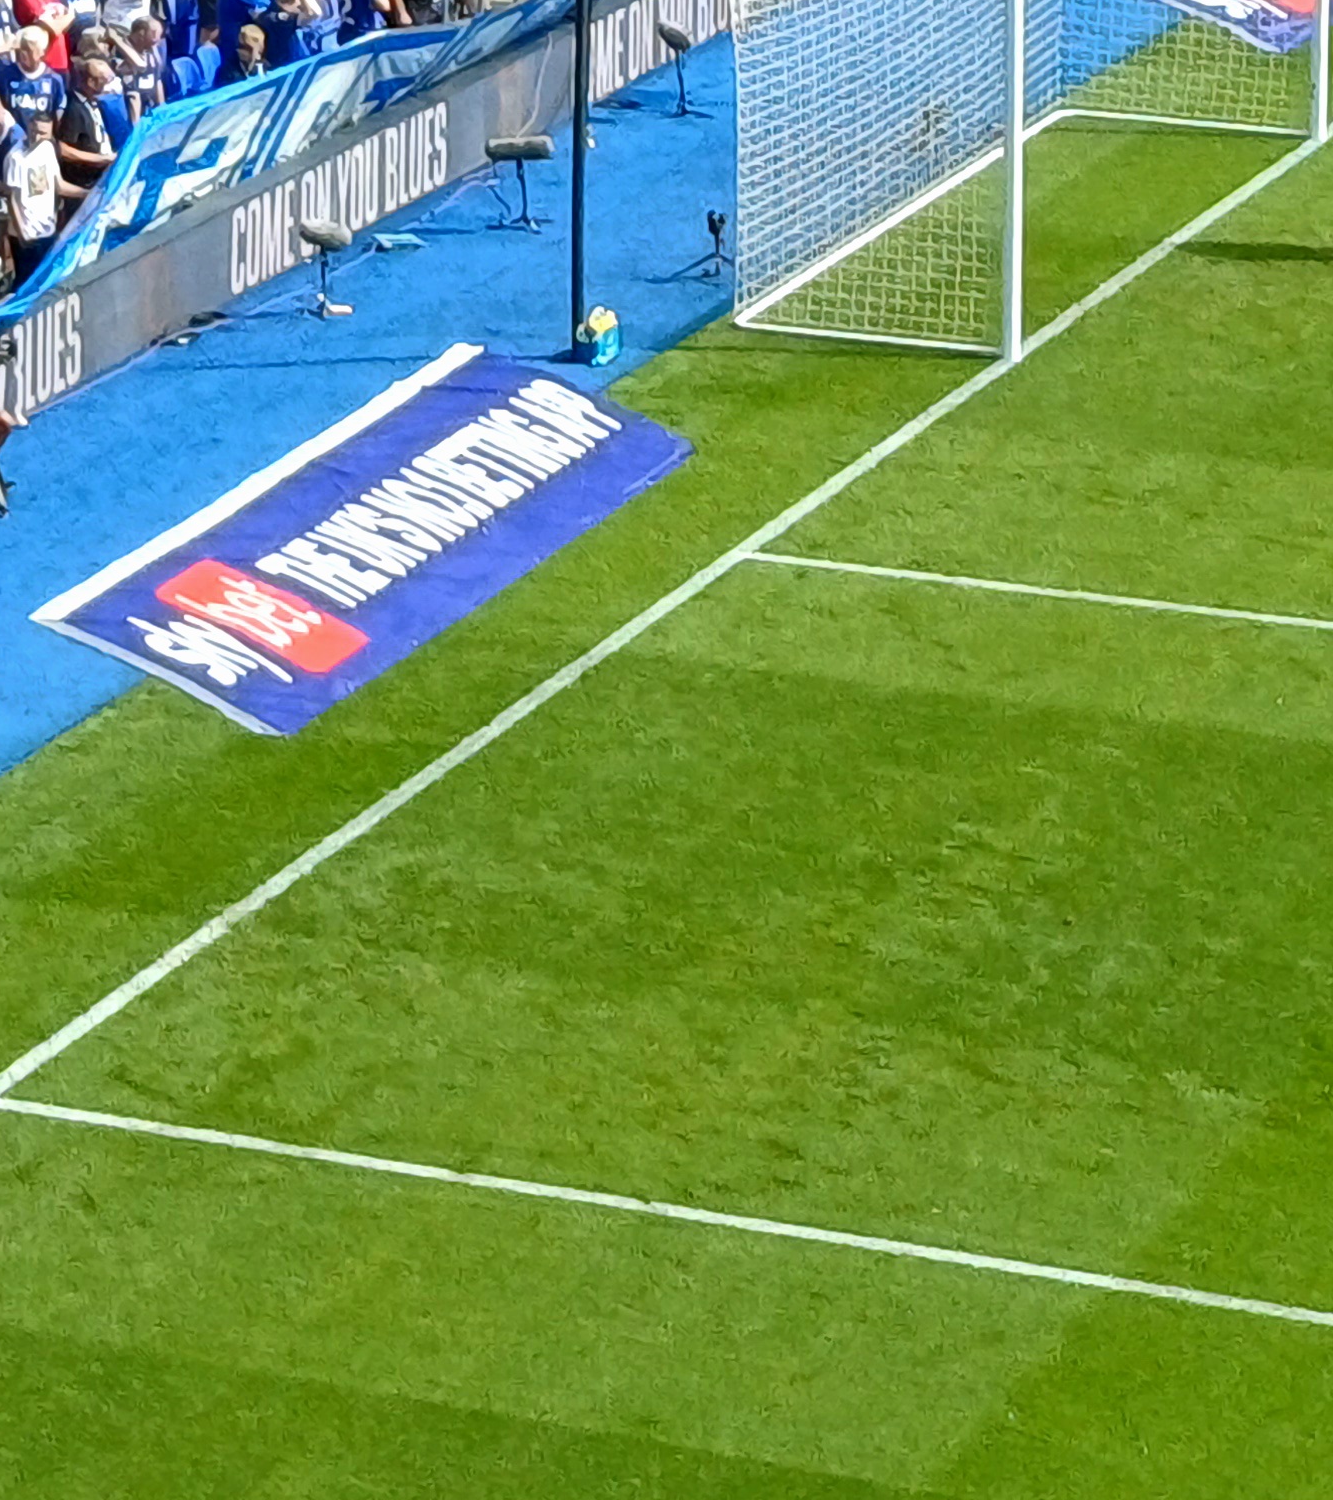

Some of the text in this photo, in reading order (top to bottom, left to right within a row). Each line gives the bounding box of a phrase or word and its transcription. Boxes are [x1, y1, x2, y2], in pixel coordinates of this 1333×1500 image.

[231, 180, 295, 295] COME
[337, 135, 380, 232] YOU
[385, 102, 448, 213] BLUES
[255, 537, 393, 608] THE
[412, 408, 586, 508] BETTING
[508, 378, 622, 449] APP
[126, 575, 321, 686] sky bet
